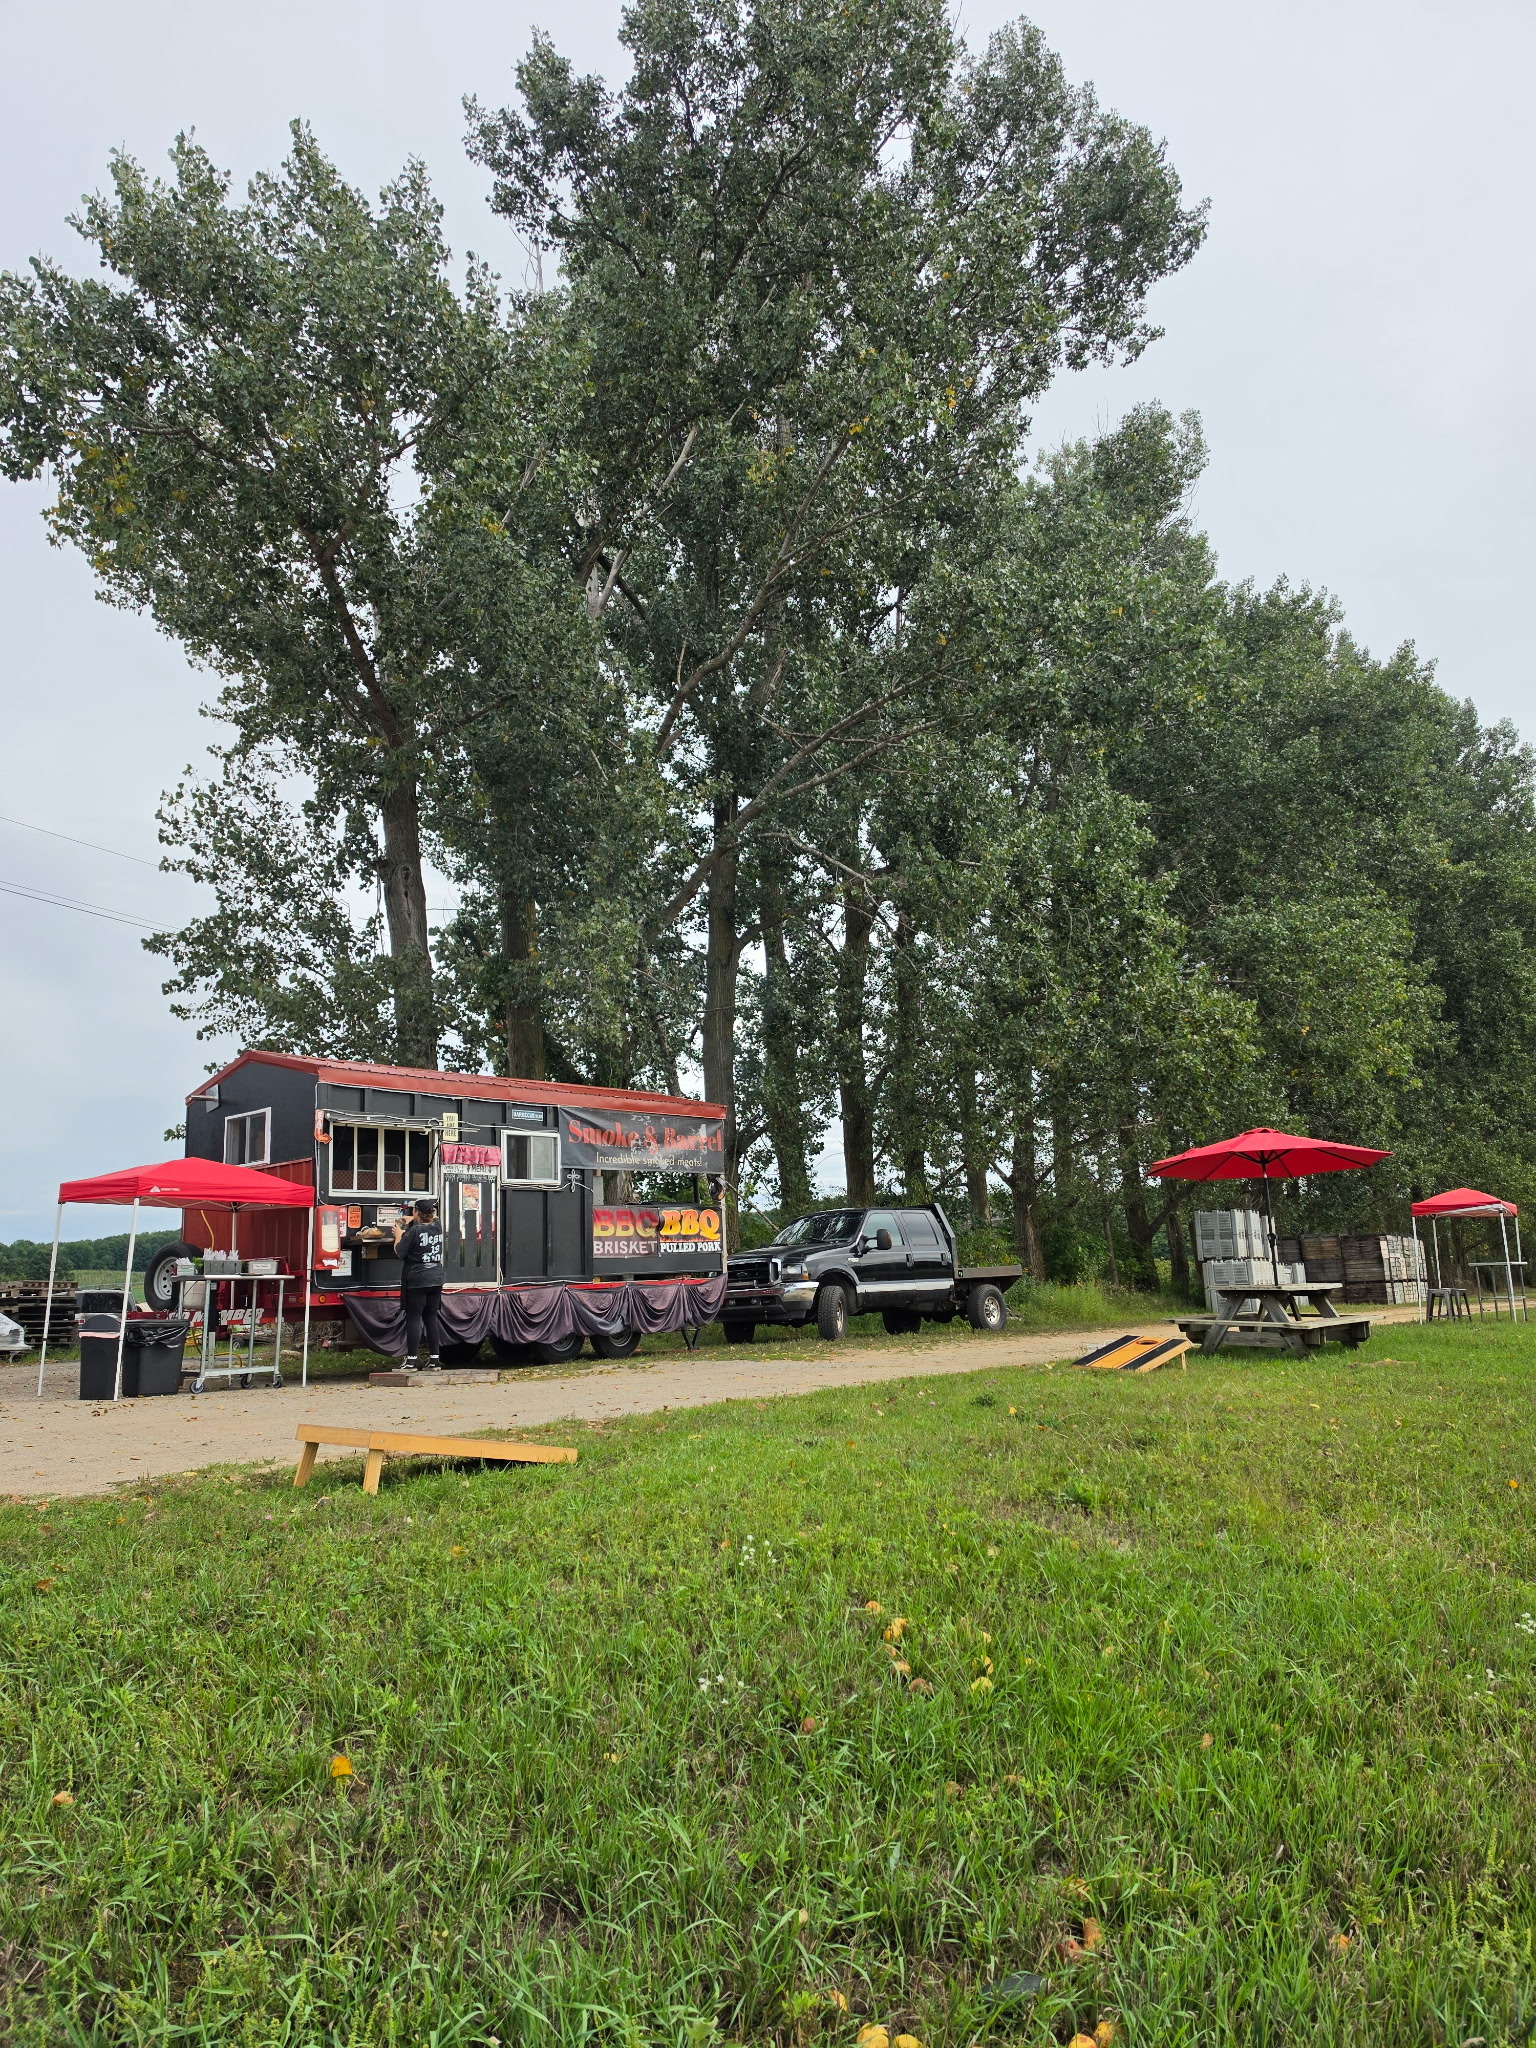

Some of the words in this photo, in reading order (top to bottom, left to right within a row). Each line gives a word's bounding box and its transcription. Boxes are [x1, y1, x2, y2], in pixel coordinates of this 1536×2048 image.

[445, 1129, 457, 1137] HERE
[568, 1120, 640, 1147] Smoke
[644, 1126, 660, 1155] &
[663, 1127, 722, 1152] Barrel
[596, 1152, 640, 1165] Incredible
[643, 1154, 675, 1166] smoked
[593, 1209, 660, 1238] BBQ
[660, 1209, 720, 1240] BBQ
[419, 1232, 443, 1246] Jesu
[593, 1240, 658, 1254] BRISKET
[660, 1242, 696, 1253] PULLED
[696, 1241, 722, 1252] PORK
